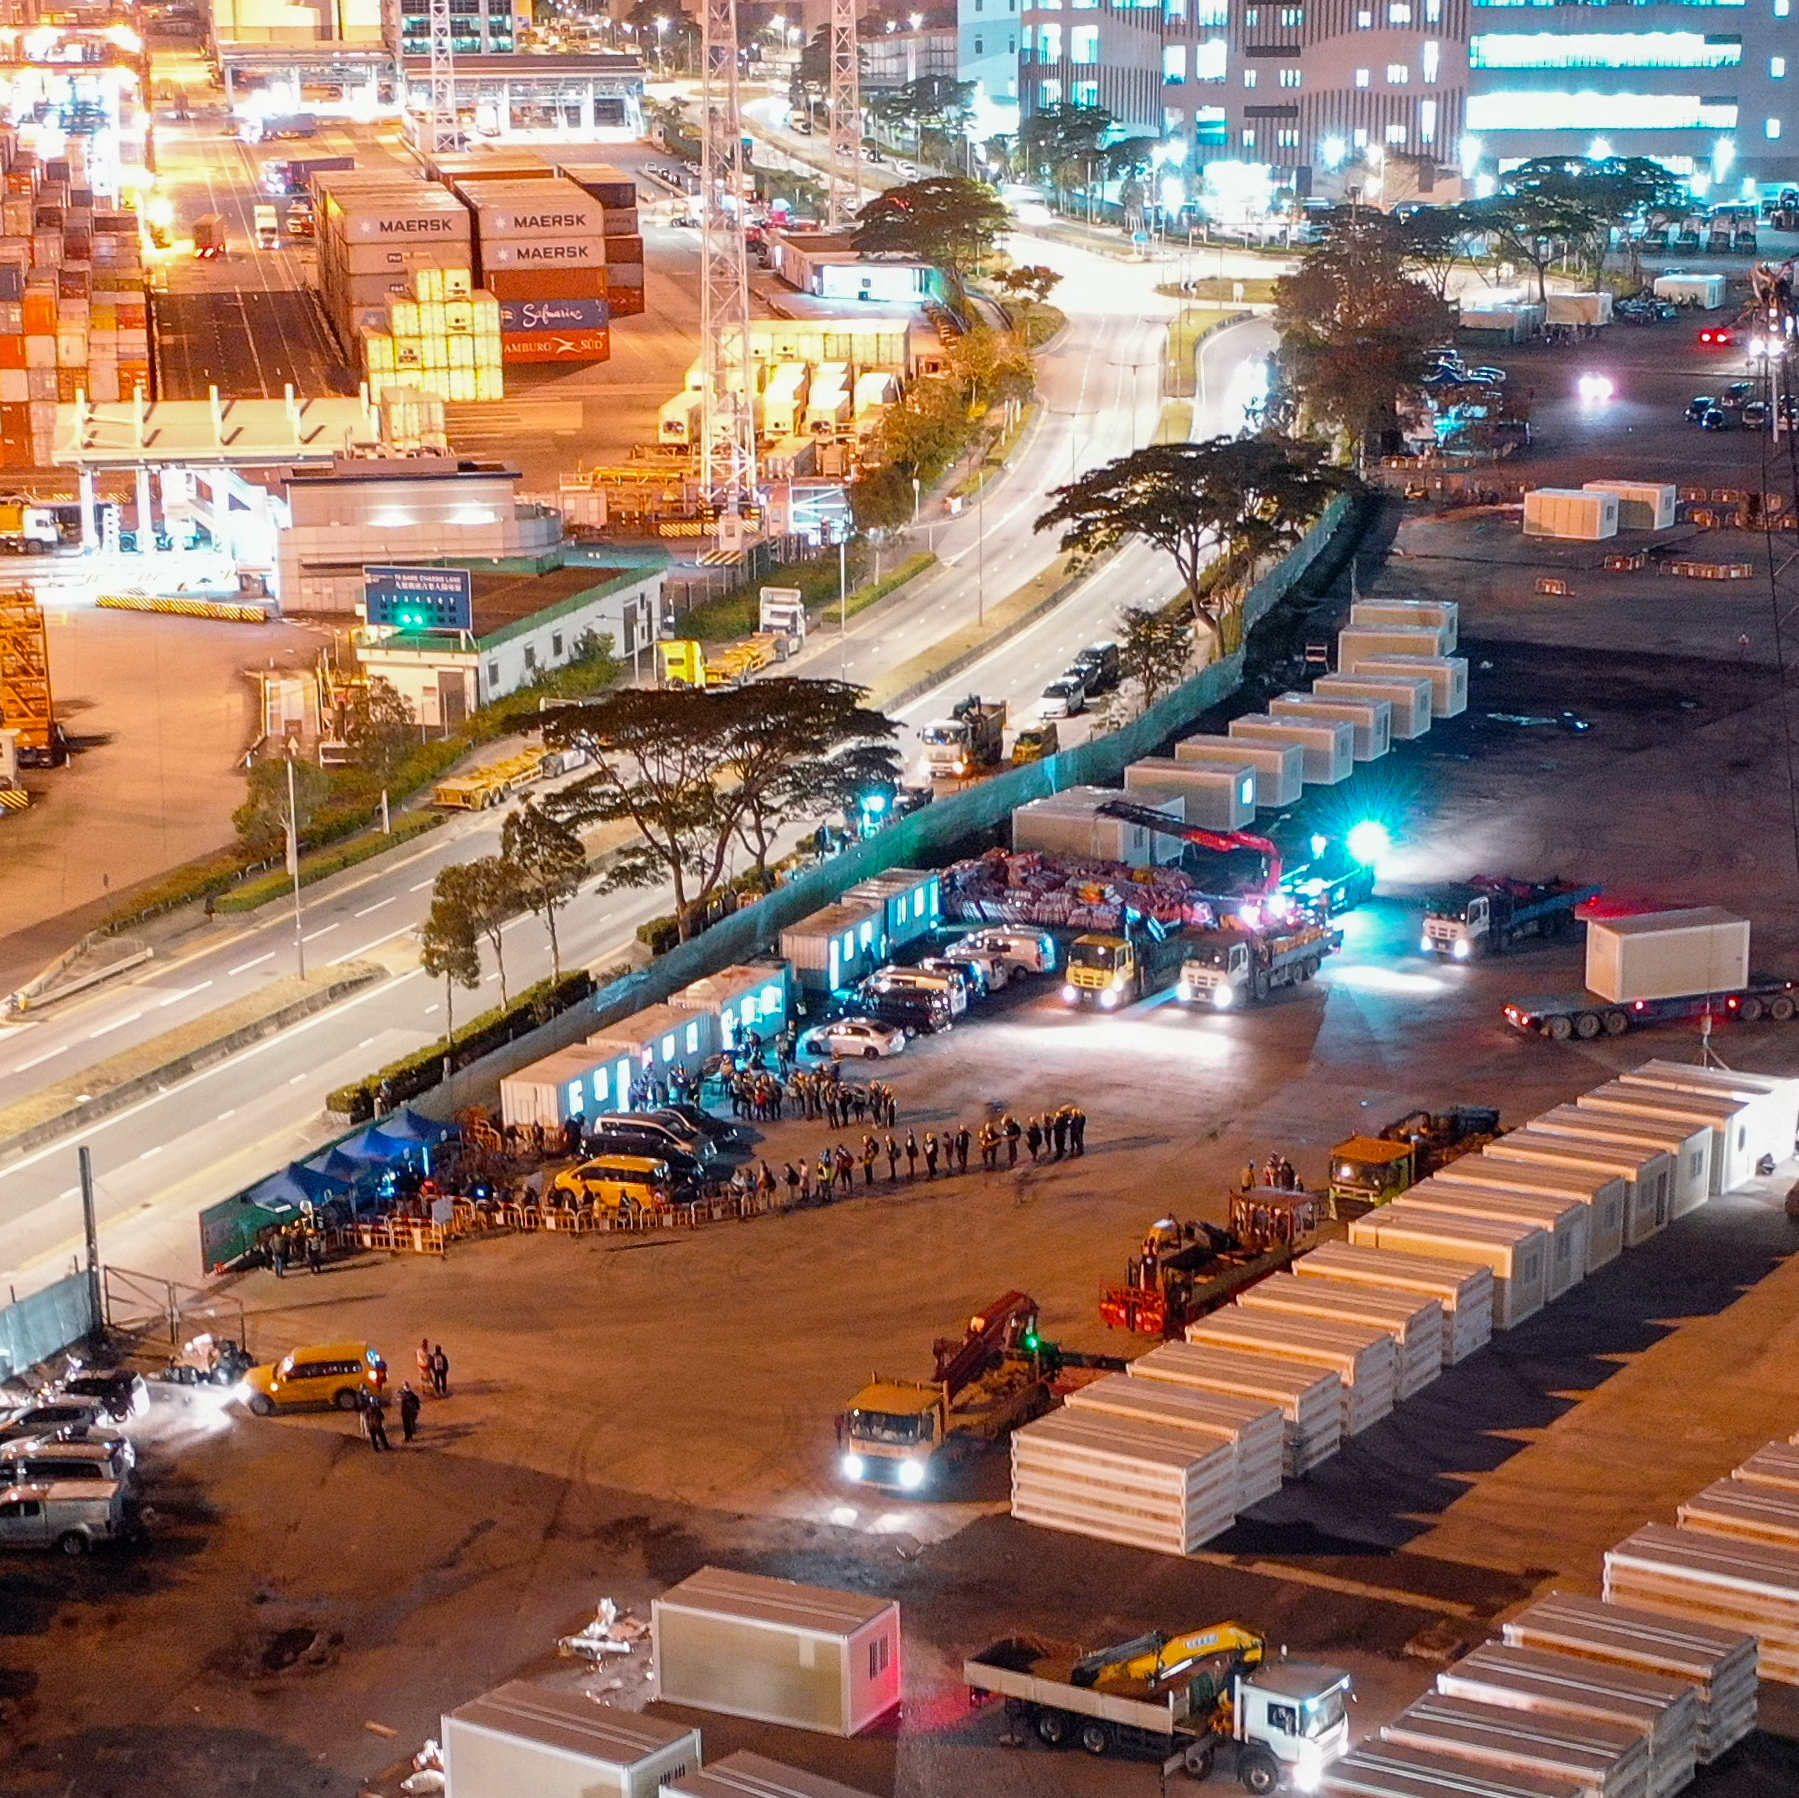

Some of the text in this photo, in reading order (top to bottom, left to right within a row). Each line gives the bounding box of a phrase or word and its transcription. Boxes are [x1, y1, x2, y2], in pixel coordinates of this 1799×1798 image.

[379, 218, 452, 233] MAERSK
[514, 214, 586, 229] MAERSK
[516, 245, 589, 260] MAERSK
[504, 341, 552, 354] AMBURG
